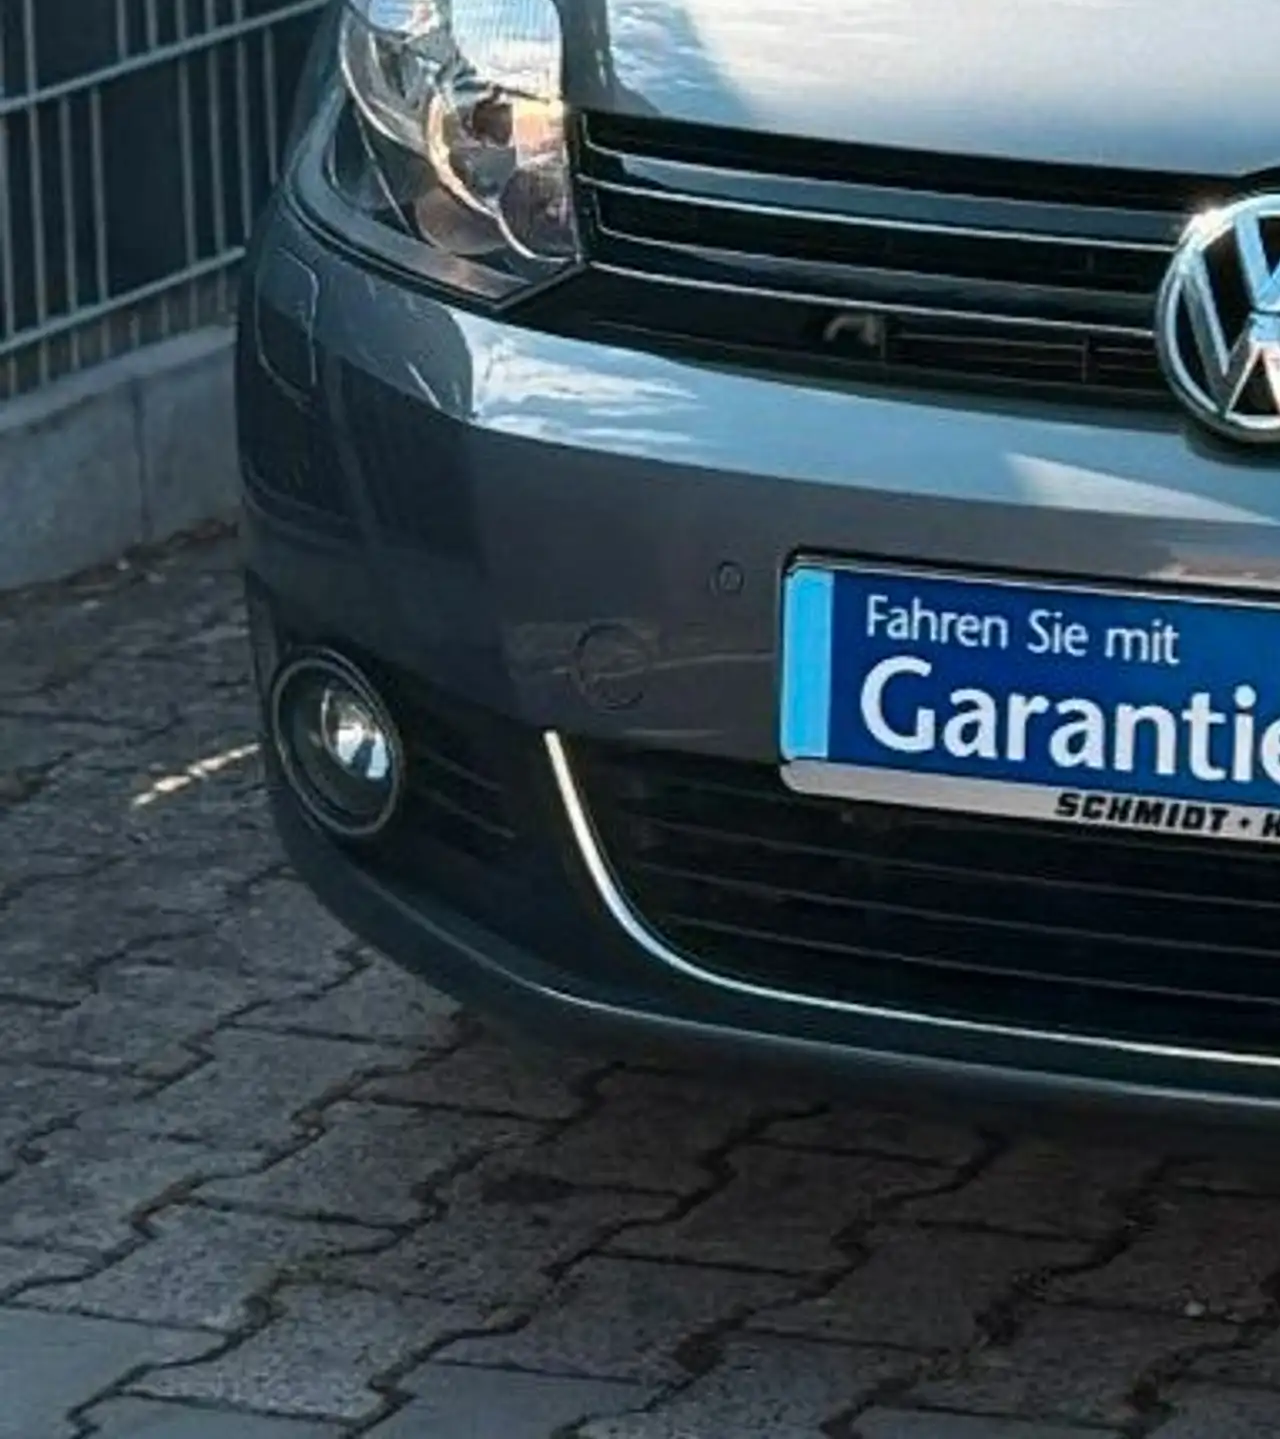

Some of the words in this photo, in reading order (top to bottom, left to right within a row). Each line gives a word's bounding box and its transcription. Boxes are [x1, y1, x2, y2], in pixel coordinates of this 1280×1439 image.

[866, 594, 1008, 649] Fahren
[1026, 609, 1090, 656] Sie
[1104, 618, 1181, 664] mit
[1053, 792, 1231, 833] SCHMIDT
